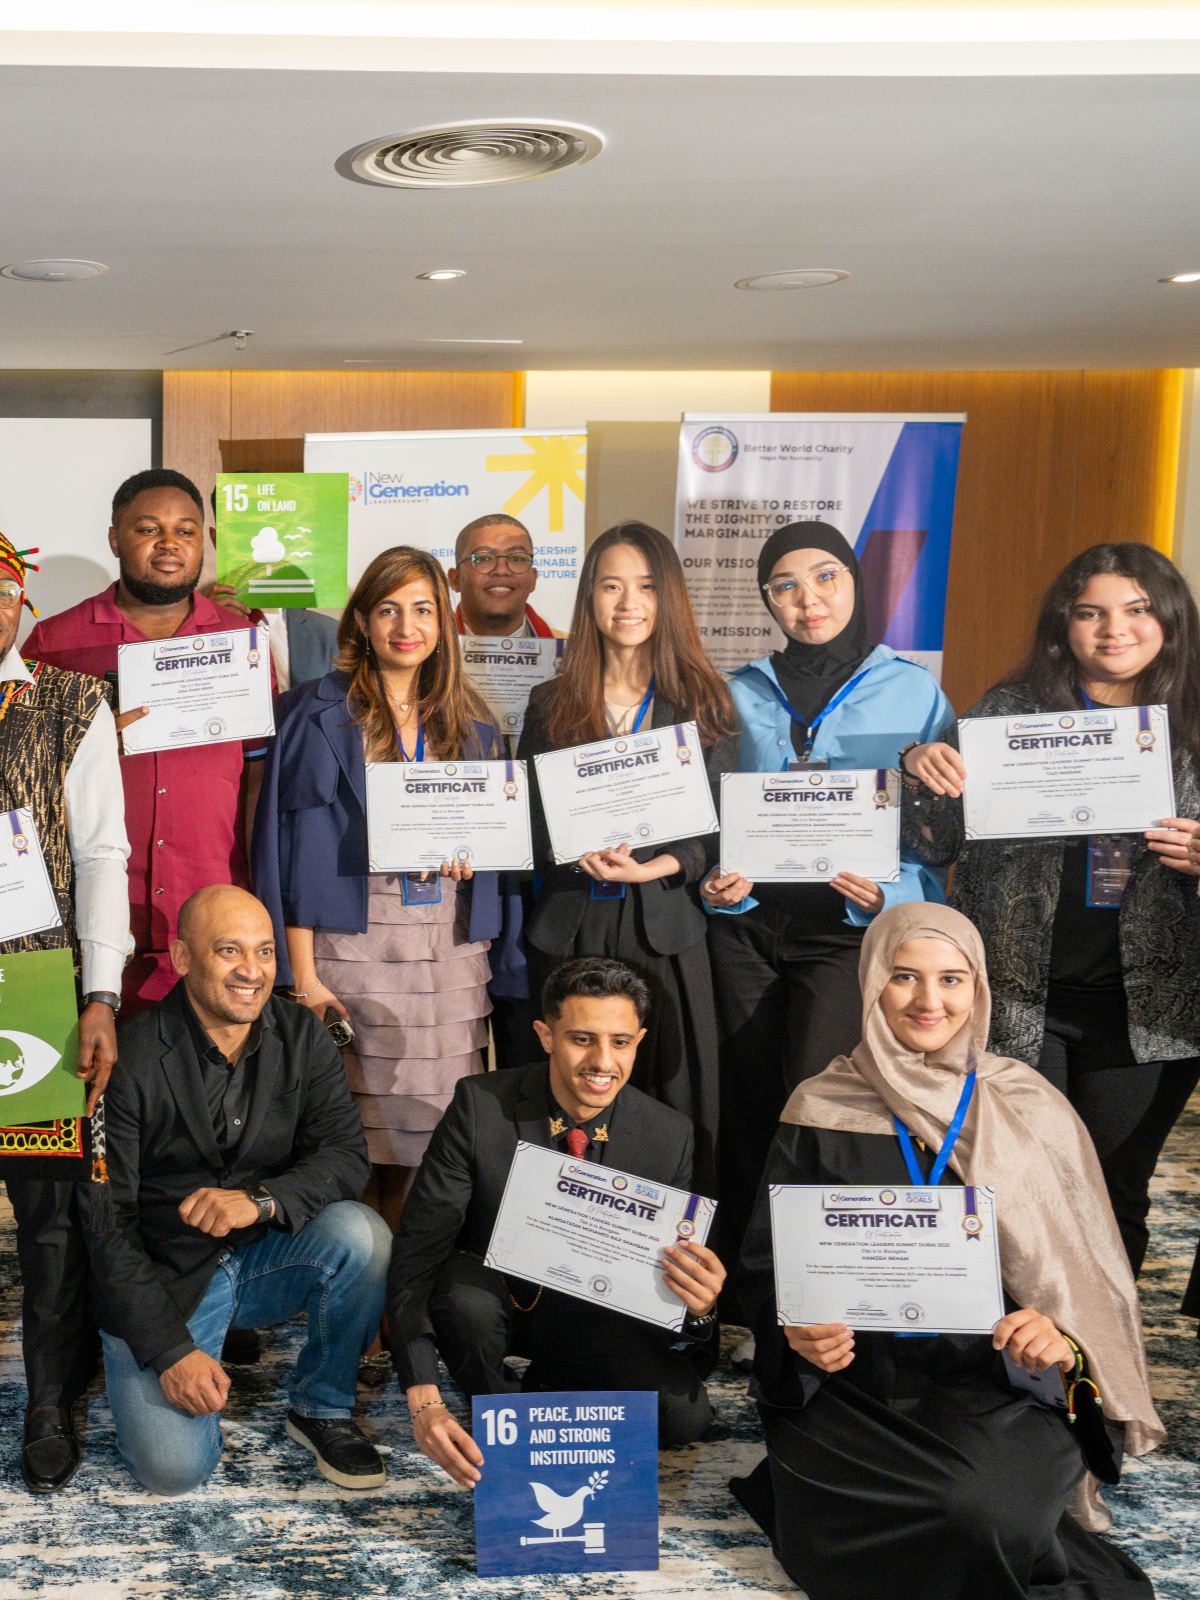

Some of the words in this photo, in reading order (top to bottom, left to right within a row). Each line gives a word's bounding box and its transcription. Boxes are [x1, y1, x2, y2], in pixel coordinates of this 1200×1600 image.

[744, 444, 777, 453] Better
[780, 444, 812, 453] World
[816, 444, 853, 454] Charity
[369, 472, 403, 484] New
[257, 484, 275, 496] LIFE
[369, 481, 469, 498] Generation
[222, 484, 249, 512] 15
[257, 500, 270, 512] ON
[272, 500, 296, 512] LAND
[687, 501, 707, 510] WE
[710, 500, 758, 510] STRIVE
[763, 501, 780, 510] TO
[784, 500, 843, 510] RESTORE
[686, 514, 710, 524] THE
[716, 514, 772, 524] DIGNITY
[776, 515, 792, 524] OF
[534, 546, 577, 555] DERSHIP
[533, 558, 577, 567] AINABLE
[683, 558, 712, 568] OUR
[716, 558, 758, 568] VISIO
[538, 570, 577, 578] FUTURE
[712, 627, 771, 637] MISSION
[156, 652, 231, 672] CERTIFICATE
[464, 654, 538, 665] CERTIFICATE
[1009, 733, 1112, 750] CERTIFICATE
[578, 752, 659, 778] CERTIFICATE
[405, 782, 486, 794] CERTIFICATE
[763, 791, 854, 802] CERTIFICATE
[577, 1168, 607, 1183] Generation
[557, 1180, 657, 1222] CERTIFICATE
[825, 1213, 937, 1228] CERTIFICATE
[530, 1407, 572, 1423] PEACE,
[575, 1406, 625, 1421] JUSTICE
[481, 1408, 518, 1446] 16
[530, 1429, 556, 1444] AND
[559, 1428, 610, 1444] STRONG
[530, 1449, 616, 1466] INSTITUTIONS
